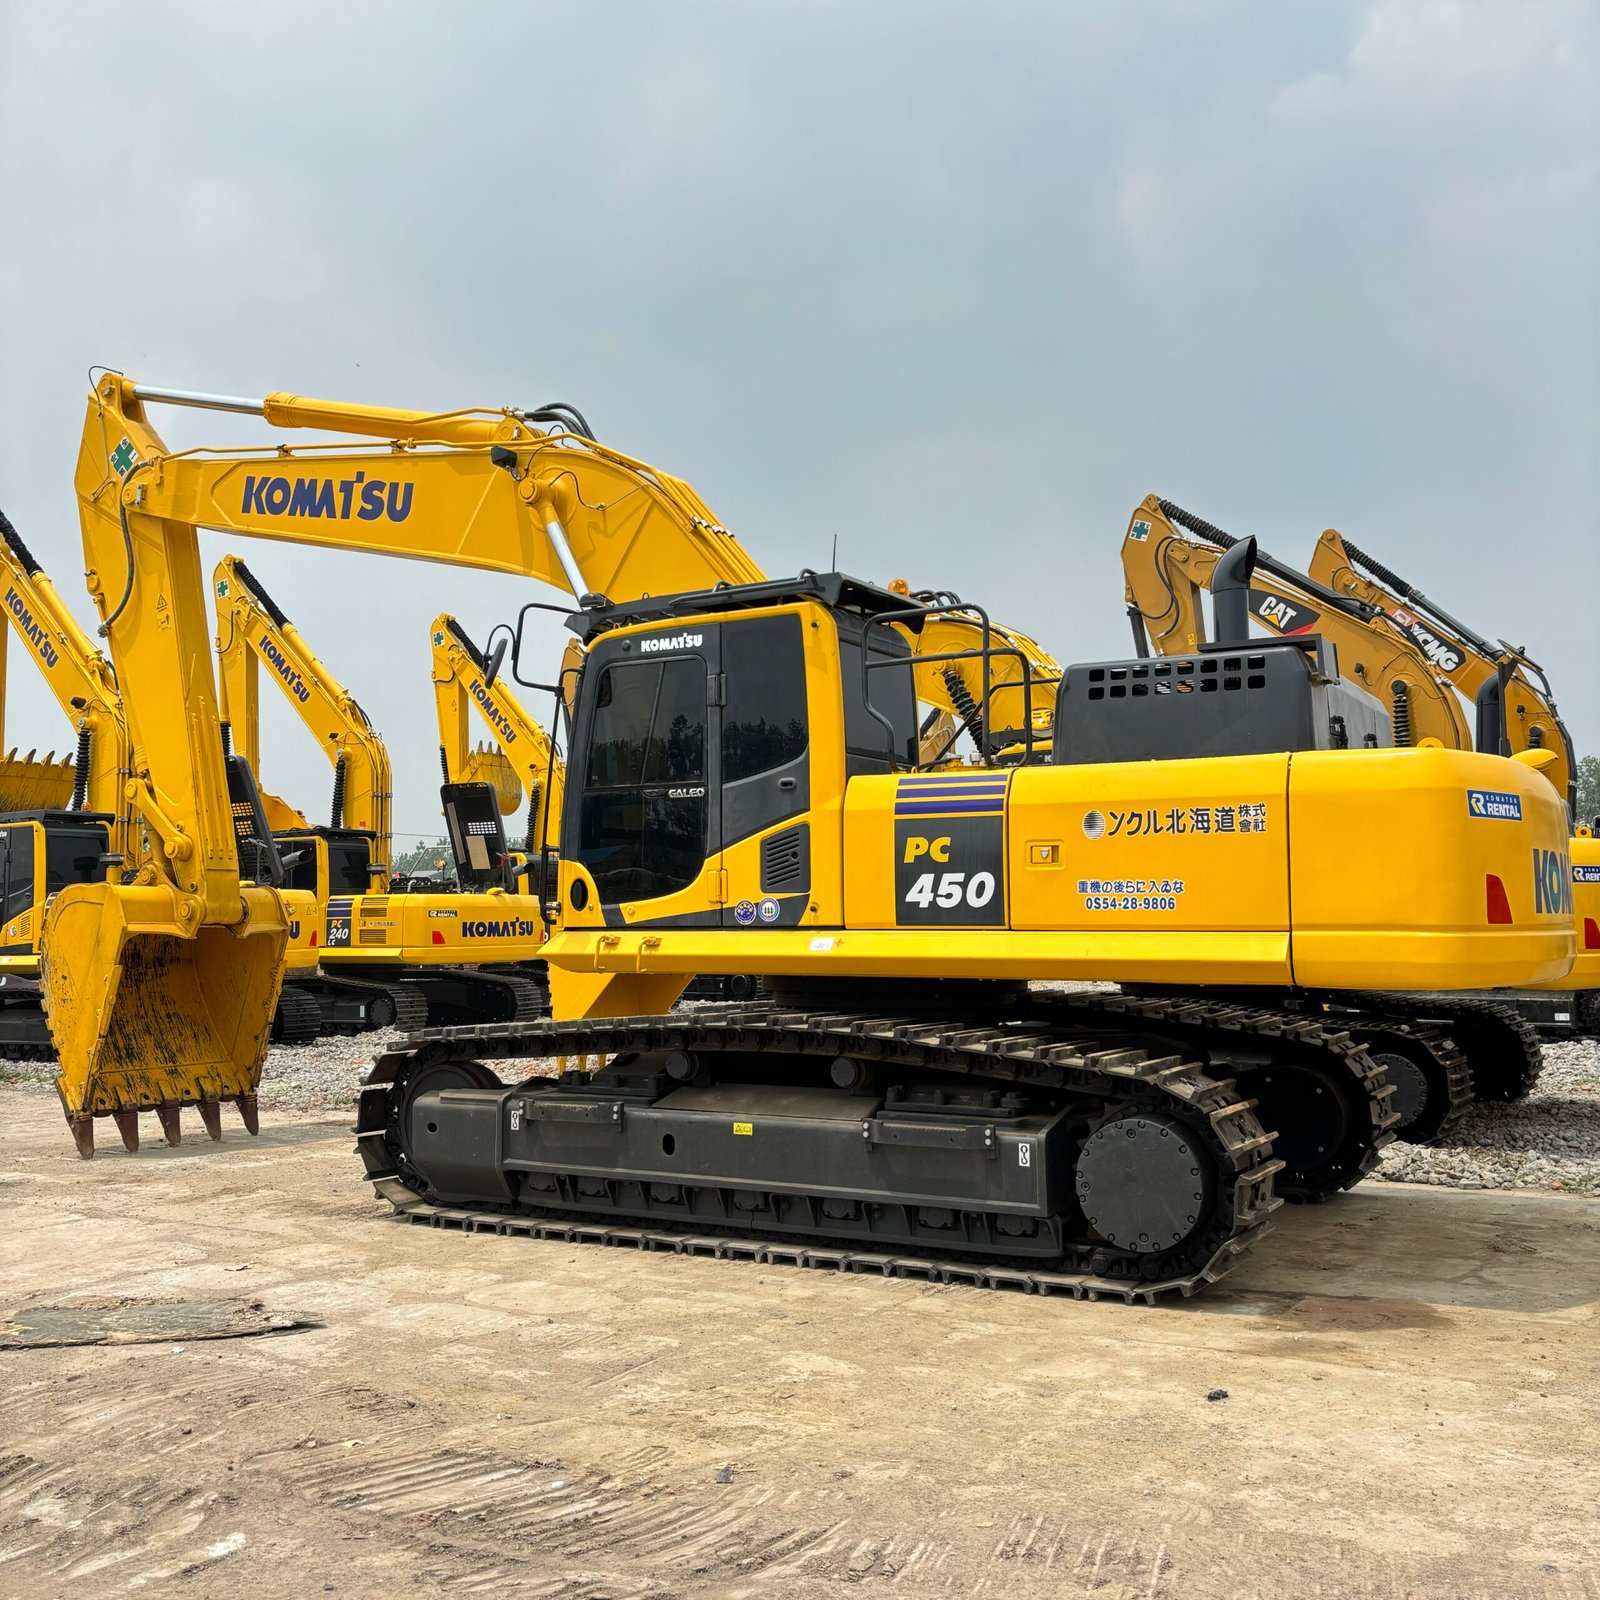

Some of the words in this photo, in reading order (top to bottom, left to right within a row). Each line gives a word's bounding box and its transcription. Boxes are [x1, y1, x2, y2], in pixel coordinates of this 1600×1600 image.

[241, 471, 414, 523] KOMATSU
[1259, 596, 1297, 629] CAT
[5, 586, 59, 668] KOMATSU
[641, 632, 703, 653] KOMATSU
[259, 635, 311, 703] KOMATSU
[469, 679, 517, 744] KOMATSU
[668, 787, 705, 798] GALEO
[1485, 795, 1517, 804] KOMATSU
[1486, 802, 1521, 818] RENTAL
[903, 836, 952, 864] PC
[905, 871, 995, 909] 450
[329, 928, 349, 940] 240
[331, 920, 342, 928] PC
[462, 916, 533, 938] KOMATSU
